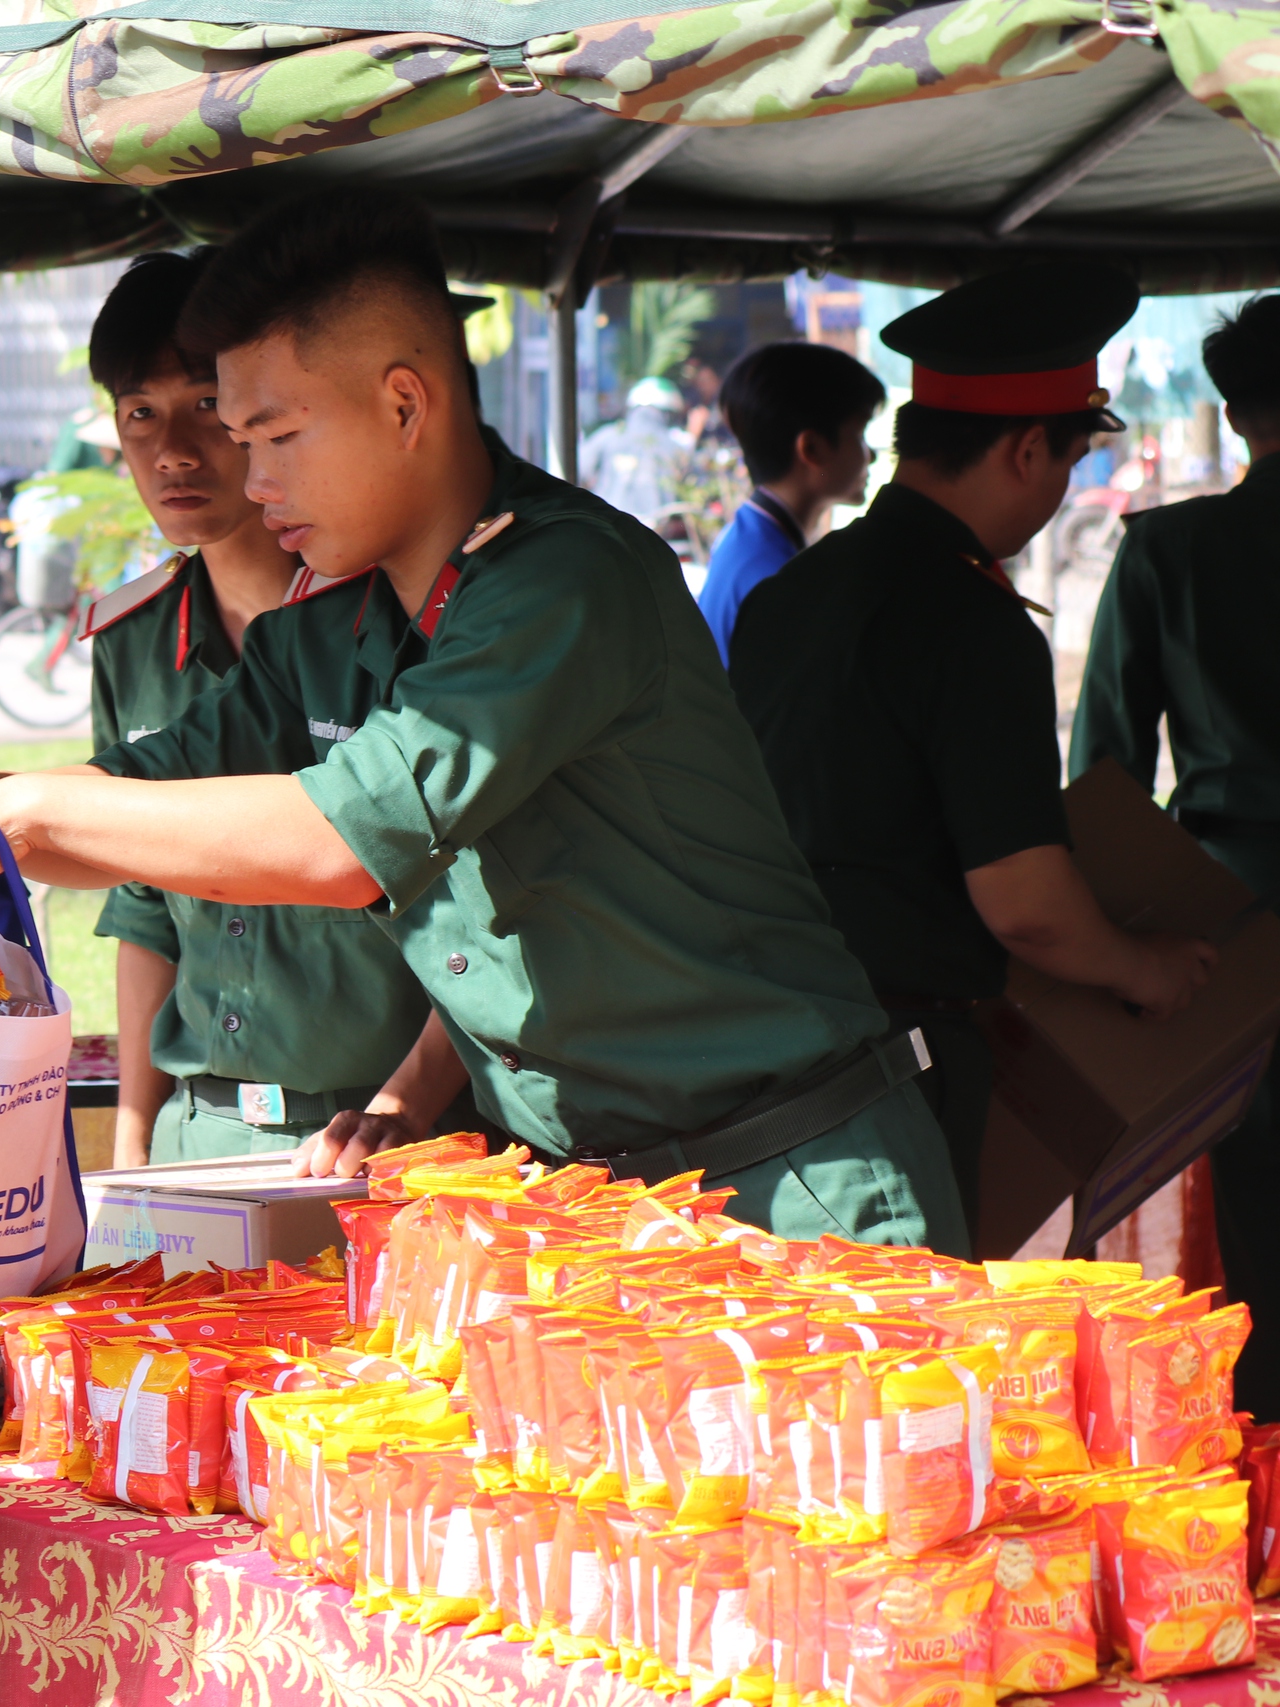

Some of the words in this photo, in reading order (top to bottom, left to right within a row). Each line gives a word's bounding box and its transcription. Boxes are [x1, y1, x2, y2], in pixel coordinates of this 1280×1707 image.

[0, 1084, 17, 1097] TY
[35, 1089, 42, 1101] &
[102, 1223, 119, 1246] ĂN
[156, 1232, 196, 1254] BIVY
[1009, 1604, 1051, 1627] BIVY
